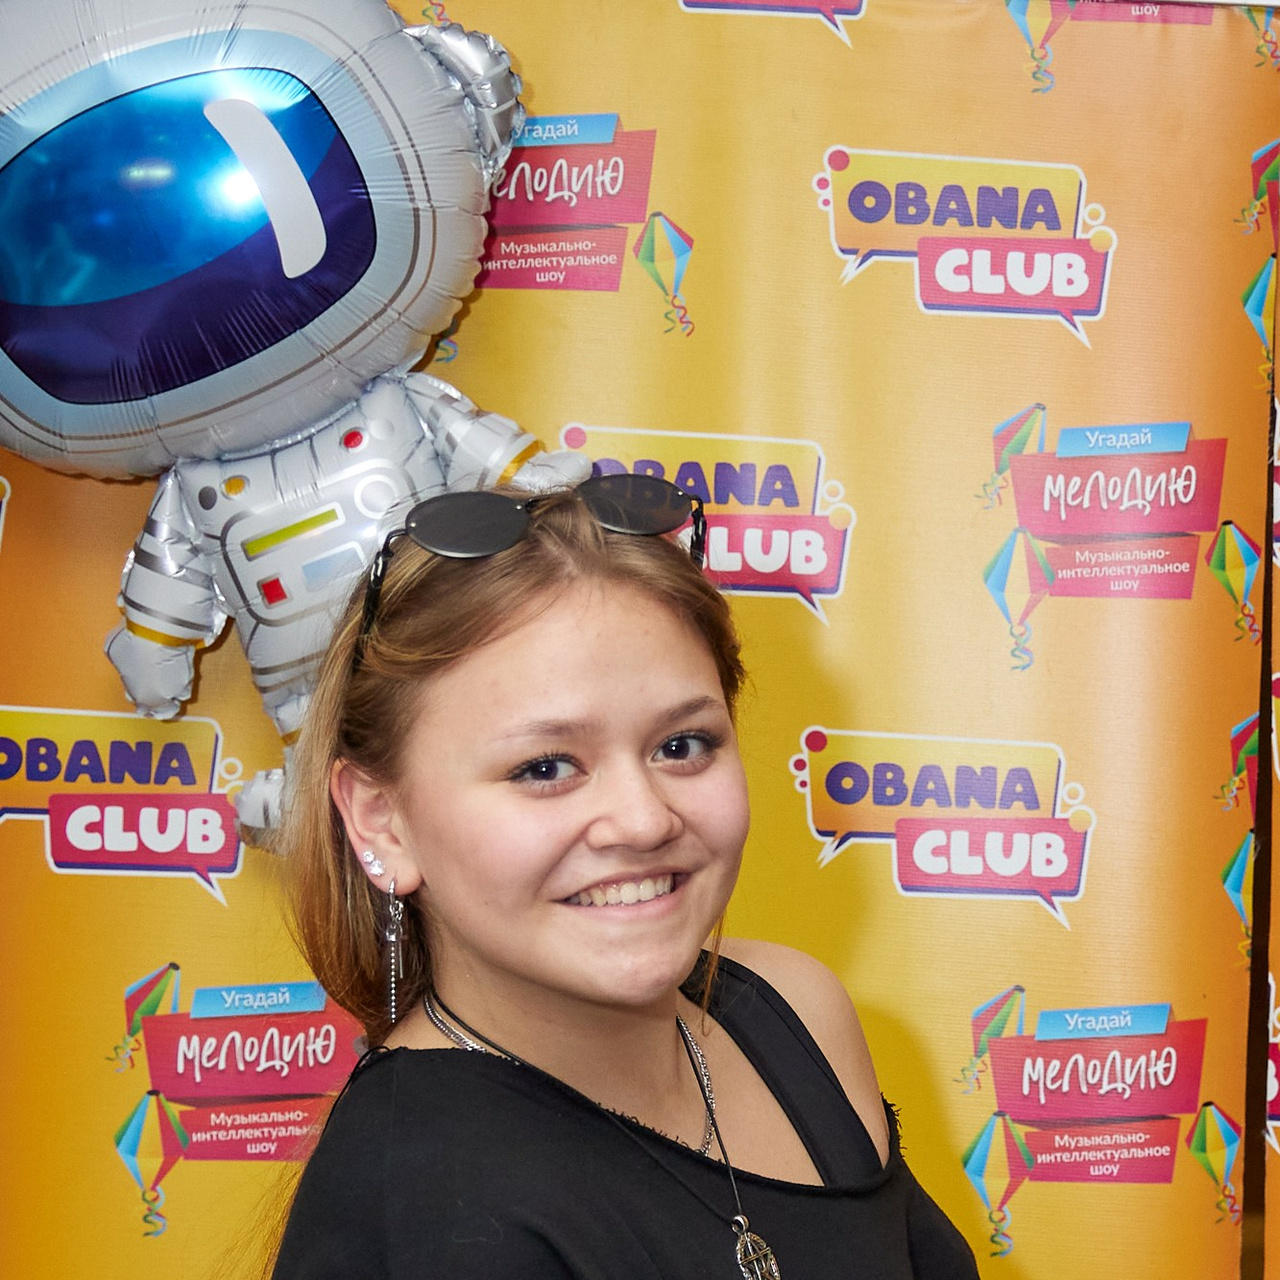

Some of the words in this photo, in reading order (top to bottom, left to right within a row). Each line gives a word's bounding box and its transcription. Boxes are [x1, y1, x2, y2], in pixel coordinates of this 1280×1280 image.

[1131, 5, 1160, 16] шоу
[848, 181, 1062, 231] OBANA
[501, 242, 597, 256] Музыкально-
[536, 271, 566, 283] шоу
[935, 248, 1089, 297] CLUB
[1084, 426, 1152, 450] Угадай
[1075, 548, 1170, 565] Музыкально-
[1057, 558, 1190, 580] интеллектуальное
[1110, 577, 1140, 592] шоу
[826, 762, 1040, 812] OBANA
[65, 805, 226, 854] CLUB
[913, 830, 1068, 878] CLUB
[222, 987, 291, 1009] Угадай
[1064, 1011, 1131, 1033] Угадай
[210, 1110, 309, 1127] Музыкально-
[246, 1141, 277, 1155] шоу
[1054, 1131, 1150, 1150] Музыкально-
[1036, 1144, 1170, 1166] интеллектуальное
[1089, 1162, 1120, 1177] шоу
